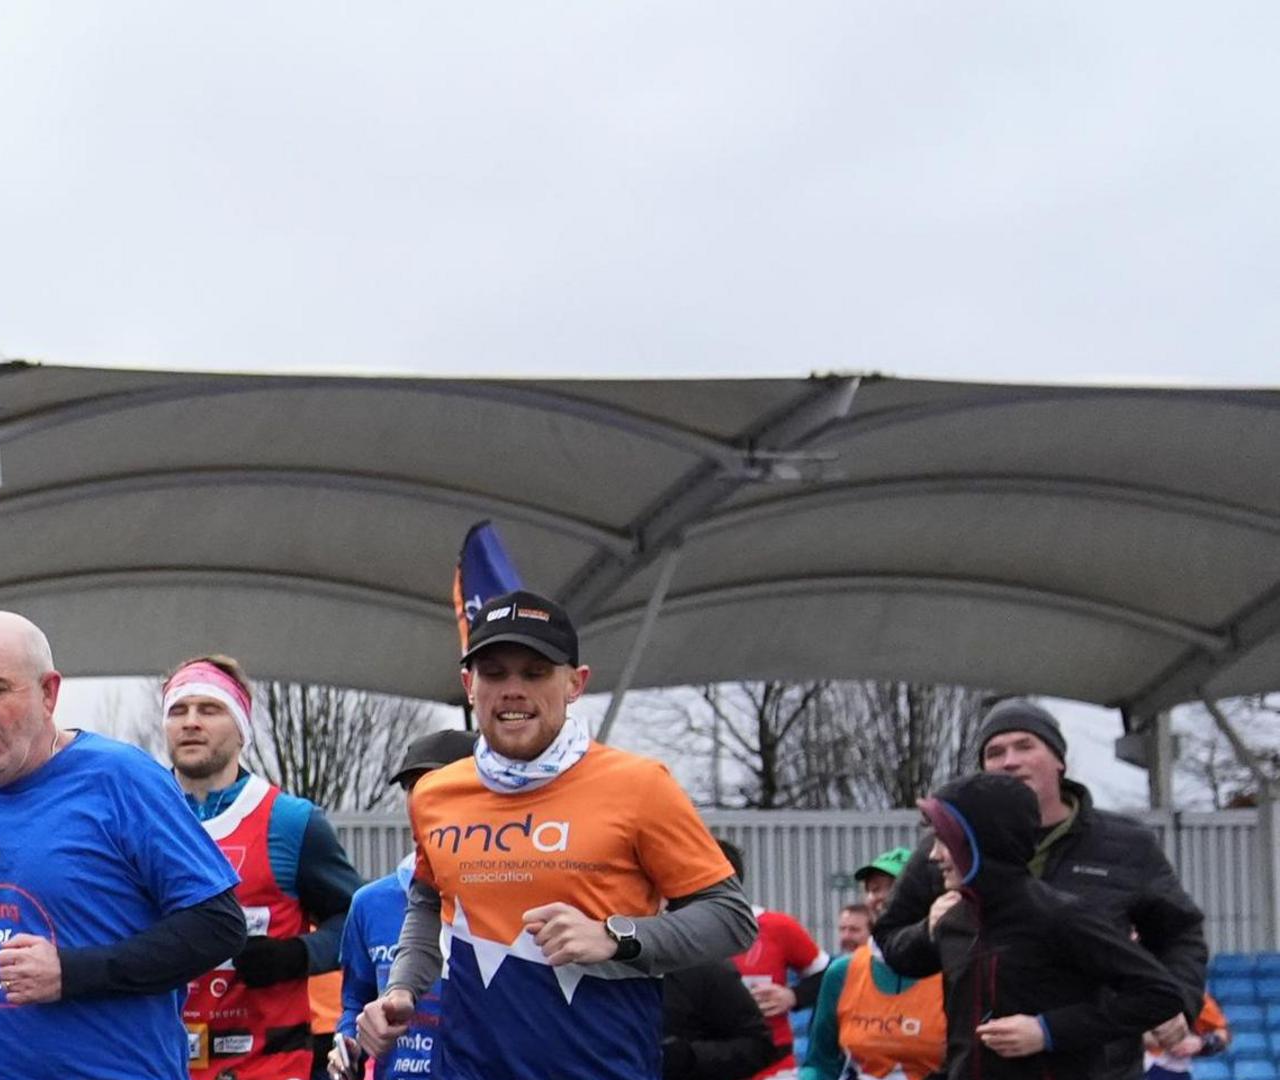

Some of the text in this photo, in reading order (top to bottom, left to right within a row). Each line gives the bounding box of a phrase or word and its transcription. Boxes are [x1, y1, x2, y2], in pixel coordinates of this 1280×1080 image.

[429, 812, 571, 854] mnda
[459, 871, 534, 884] association
[396, 1032, 433, 1051] moto
